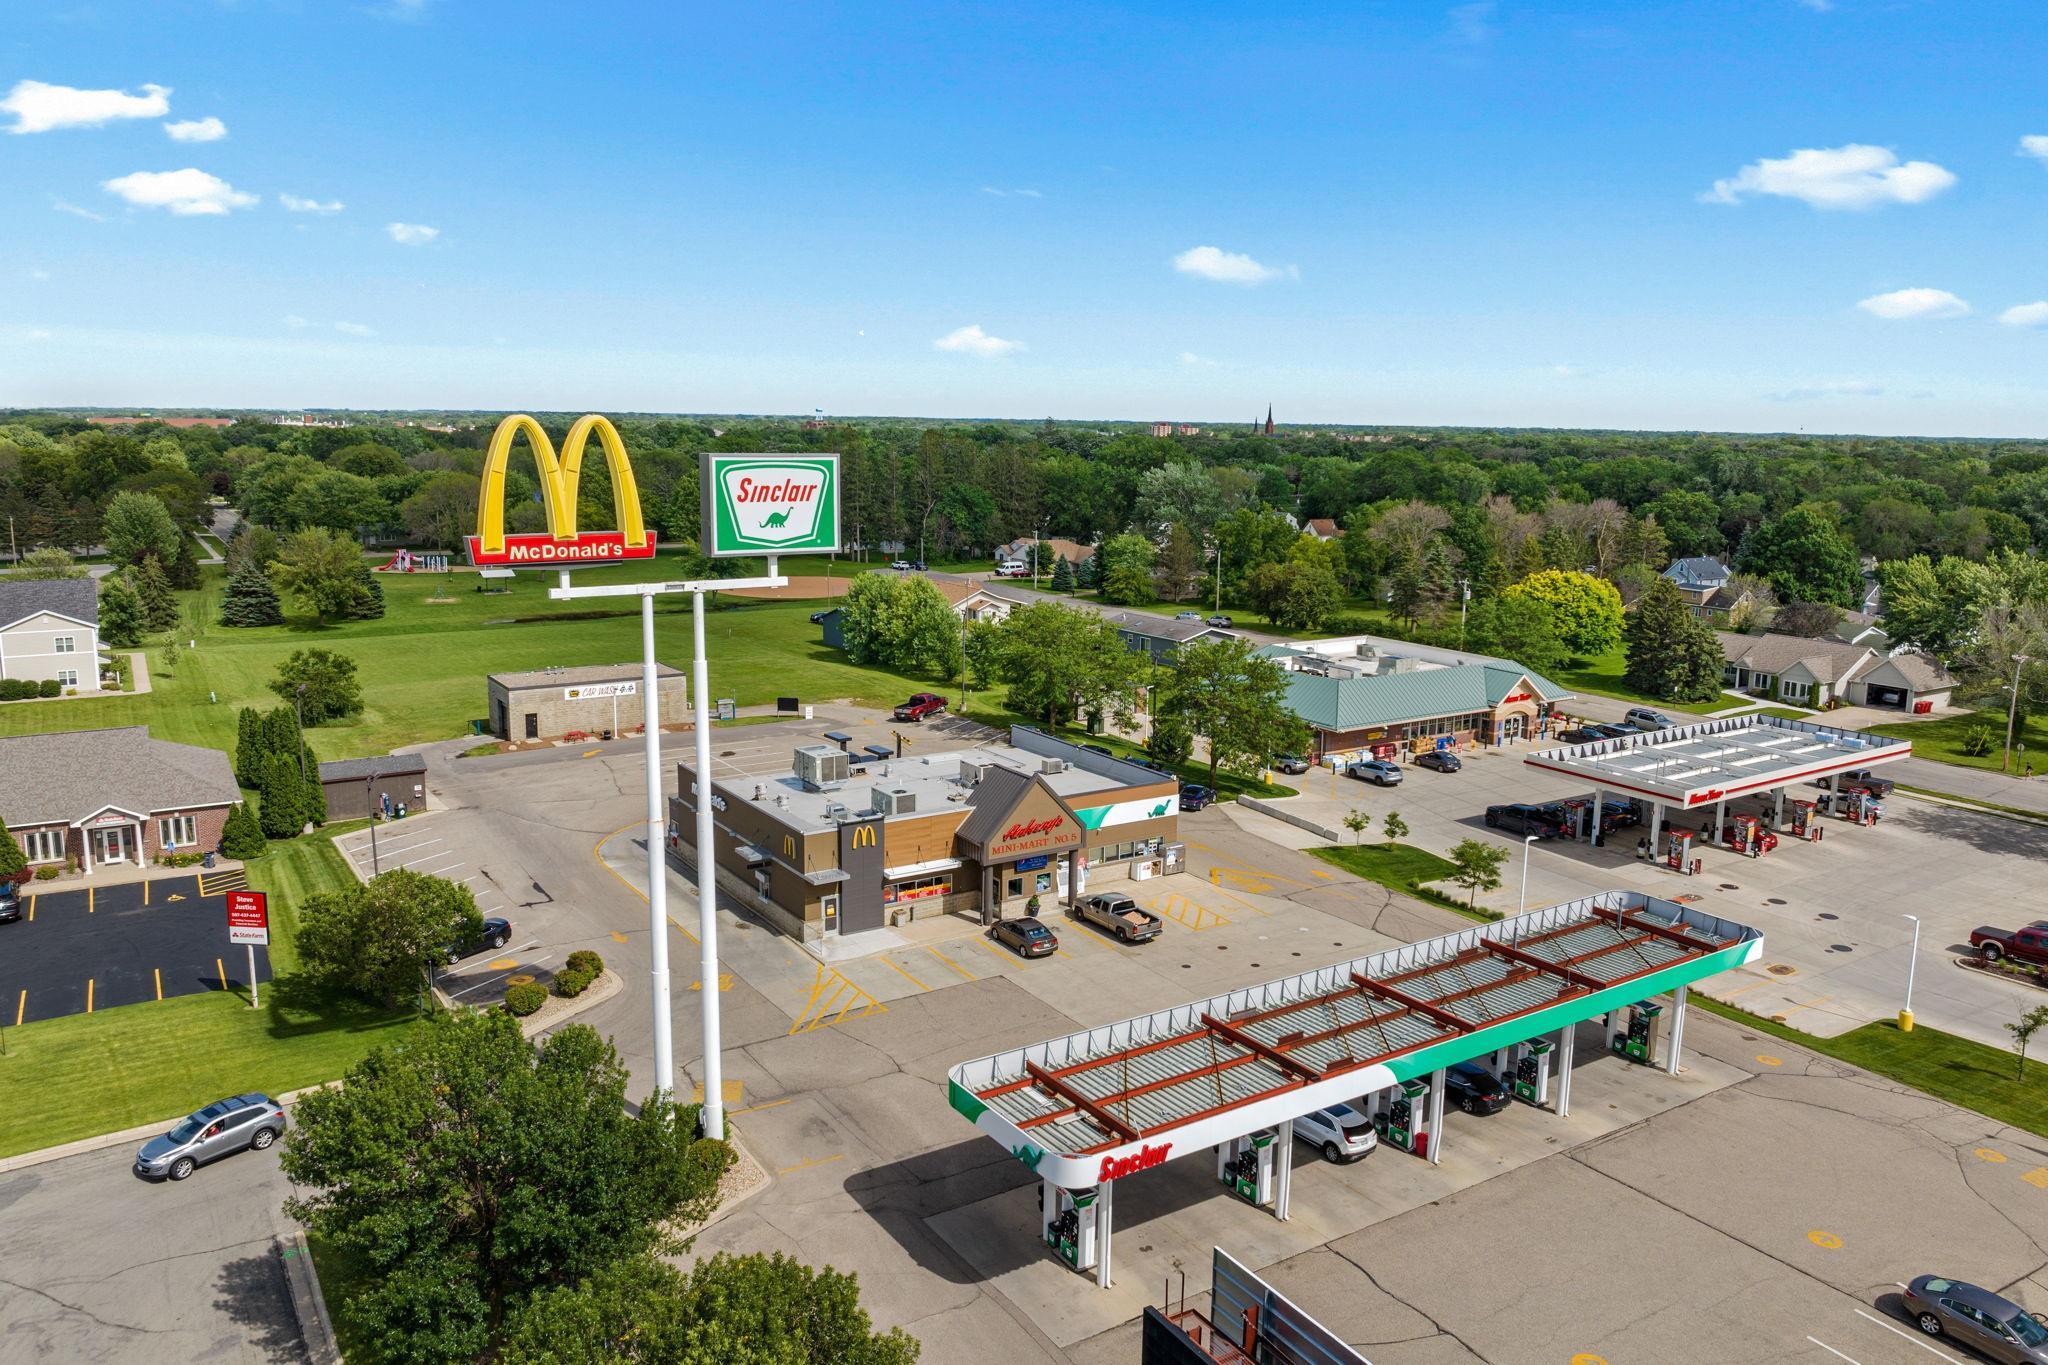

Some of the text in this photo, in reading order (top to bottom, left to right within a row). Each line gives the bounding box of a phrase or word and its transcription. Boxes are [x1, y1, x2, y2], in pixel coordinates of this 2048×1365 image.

[737, 477, 818, 503] Sinclair
[509, 543, 623, 560] McDonald's
[582, 688, 597, 697] CAR
[991, 838, 1049, 855] MINI-MART
[1071, 833, 1077, 841] 5
[1097, 1142, 1173, 1183] Sinclair
